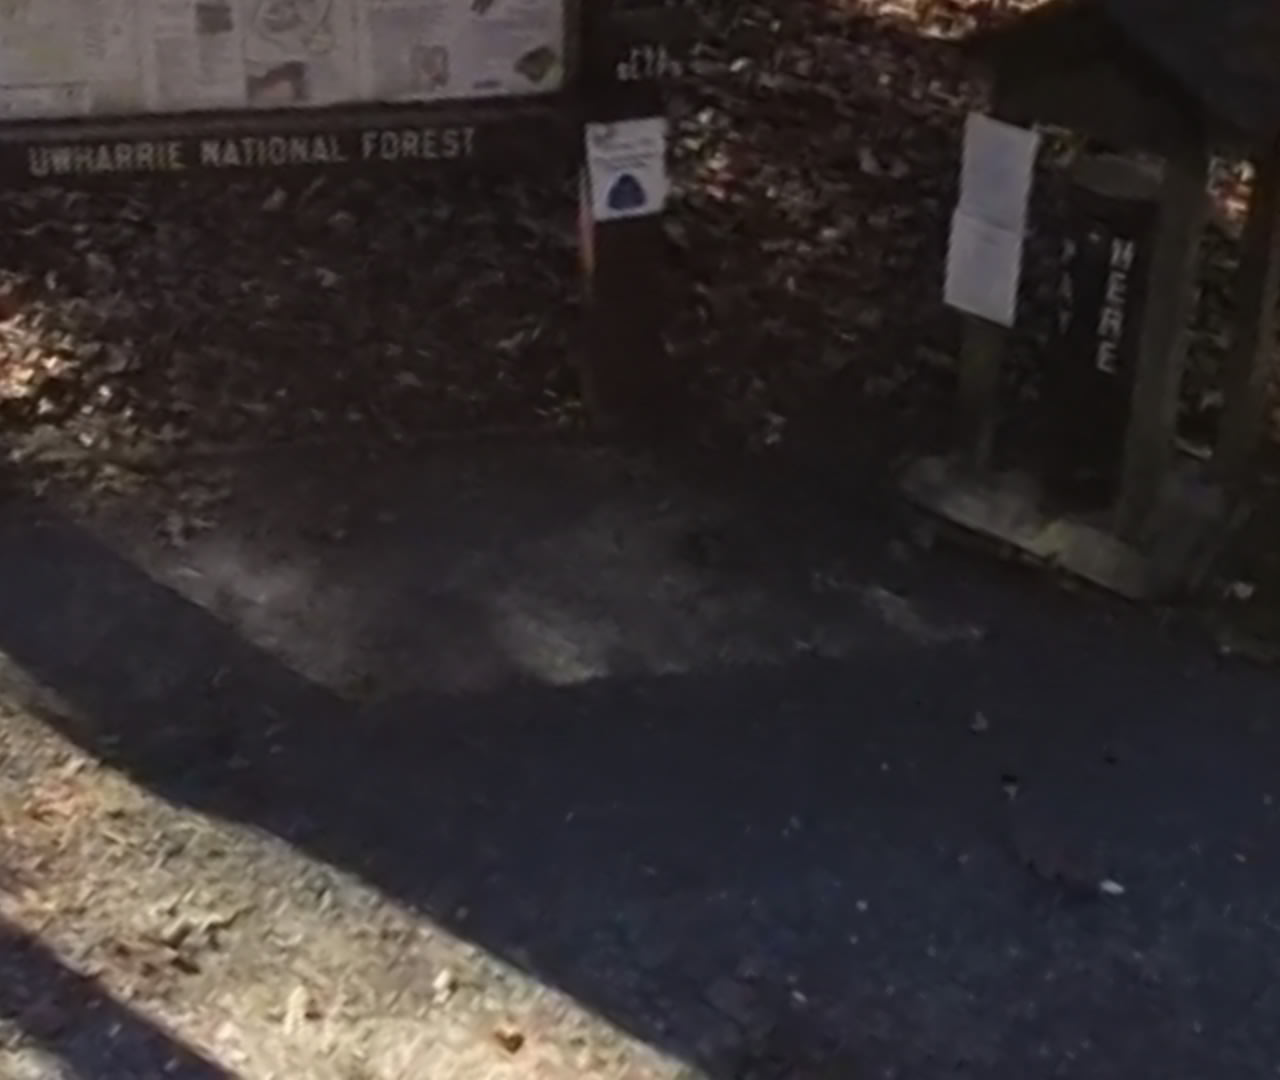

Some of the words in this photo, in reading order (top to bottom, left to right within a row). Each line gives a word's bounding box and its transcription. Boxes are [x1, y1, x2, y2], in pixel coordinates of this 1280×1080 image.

[28, 141, 187, 177] UWHARRIE
[199, 135, 348, 168] NATIONAL
[361, 127, 477, 159] FOREST
